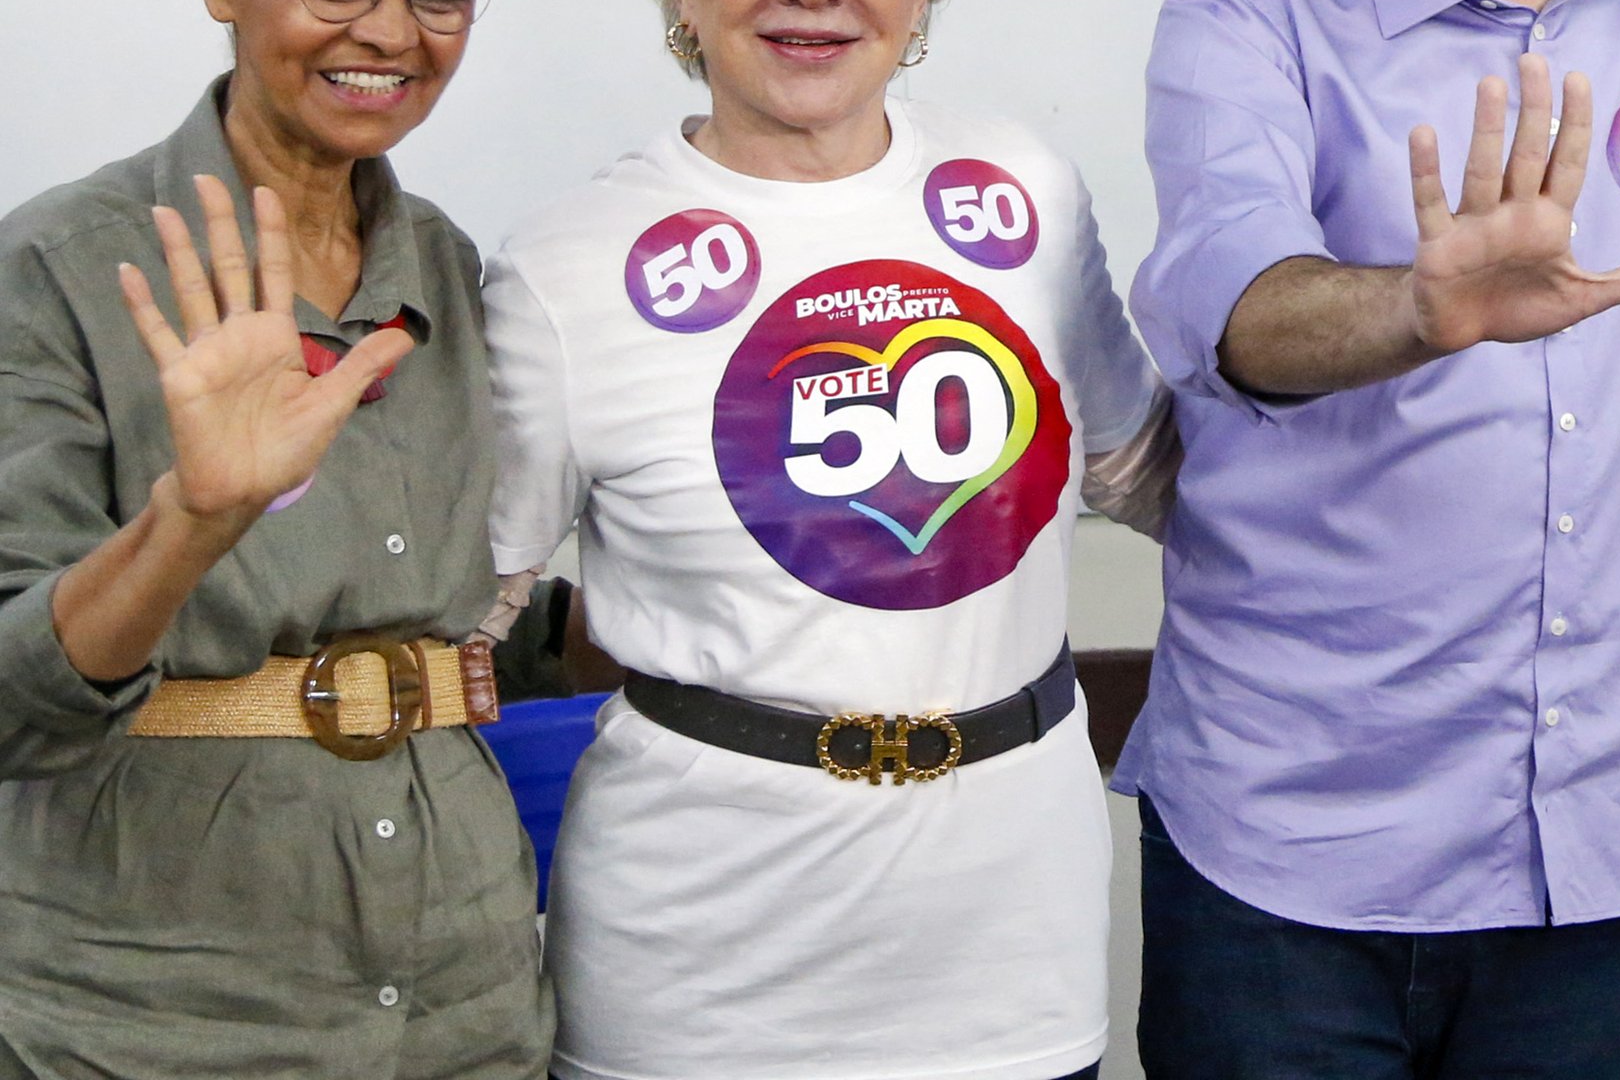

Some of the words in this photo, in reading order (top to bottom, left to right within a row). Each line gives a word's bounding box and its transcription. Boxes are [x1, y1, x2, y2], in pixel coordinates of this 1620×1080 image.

[939, 182, 1030, 243] 50
[642, 222, 748, 318] 50
[796, 284, 903, 318] BOULOS
[903, 288, 949, 296] PREFEITO
[827, 309, 854, 321] VICE
[858, 297, 961, 327] MARTA
[795, 366, 884, 400] VOTE
[784, 350, 1008, 497] 50
